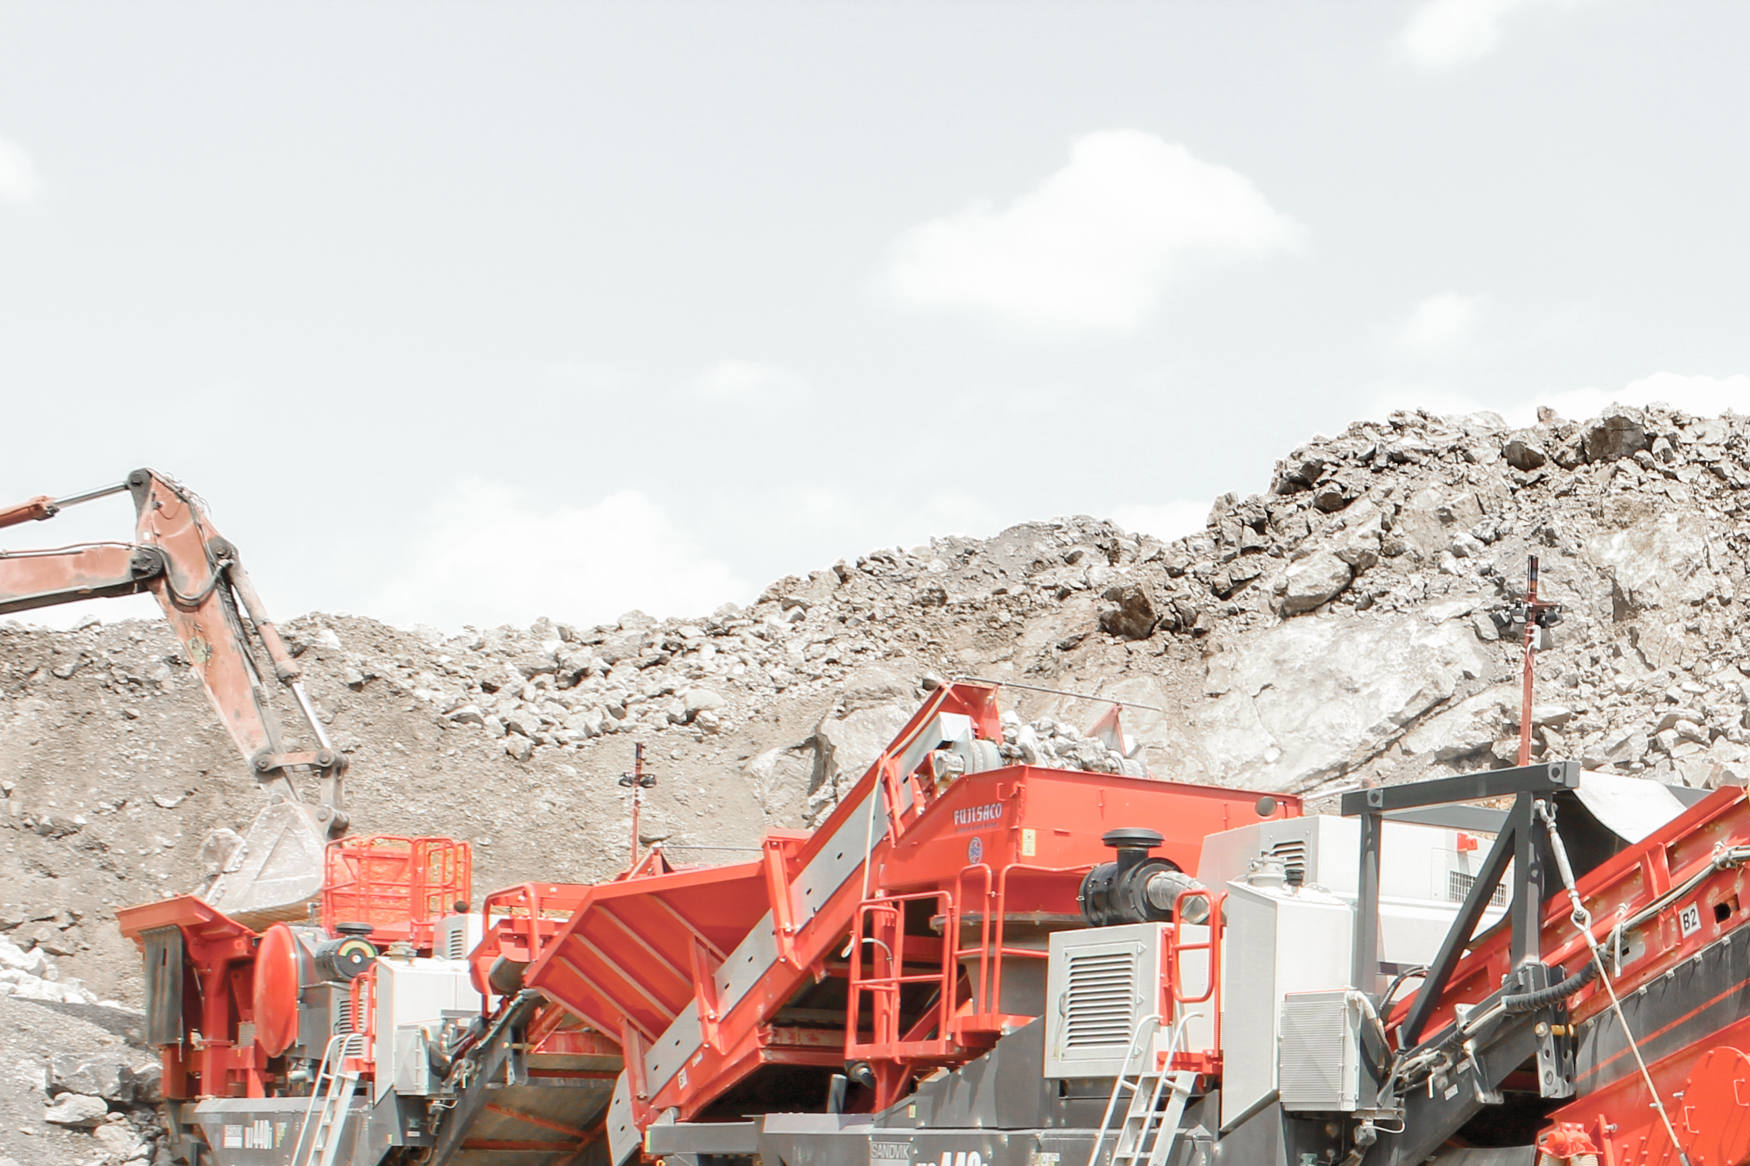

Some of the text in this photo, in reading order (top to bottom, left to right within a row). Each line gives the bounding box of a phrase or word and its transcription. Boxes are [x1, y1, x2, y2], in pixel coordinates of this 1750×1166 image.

[954, 802, 1002, 825] FUJISACO
[1683, 908, 1697, 931] B2
[871, 1142, 909, 1160] SANDVIK
